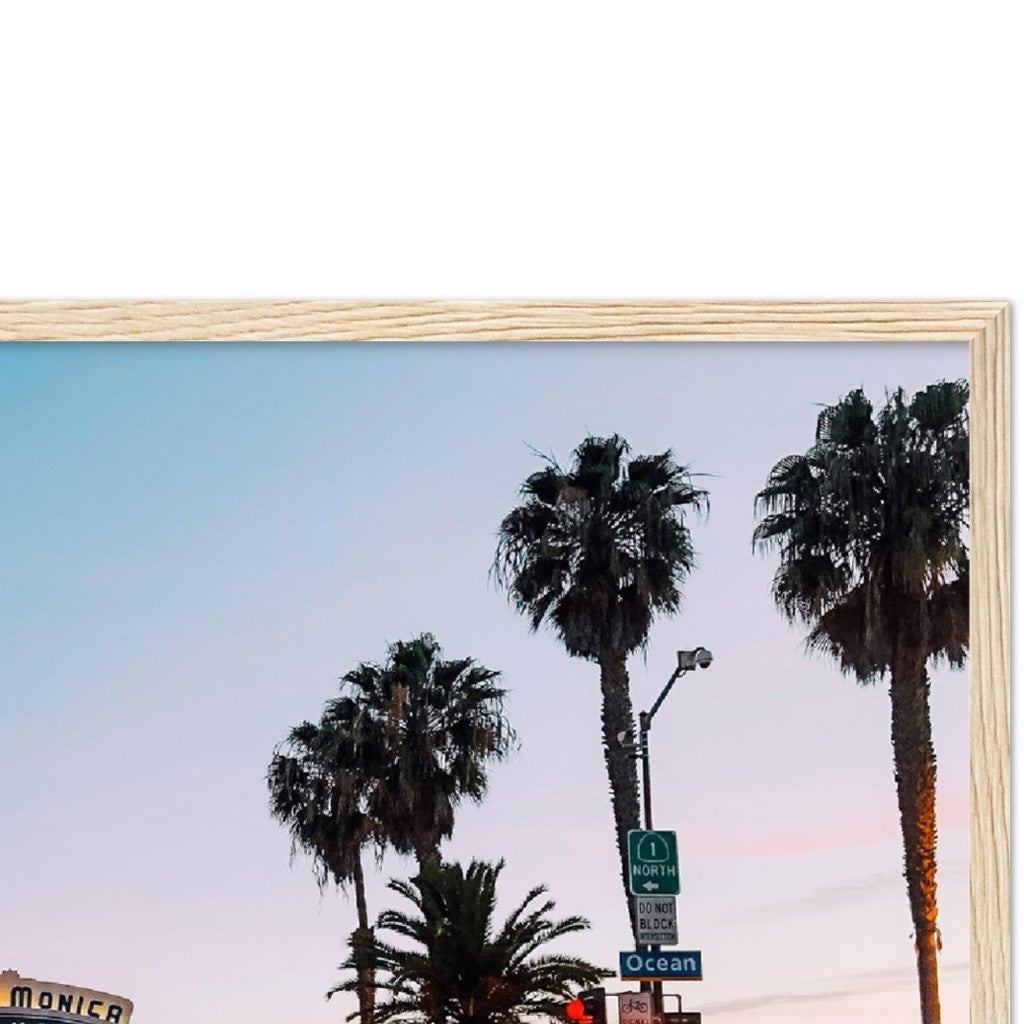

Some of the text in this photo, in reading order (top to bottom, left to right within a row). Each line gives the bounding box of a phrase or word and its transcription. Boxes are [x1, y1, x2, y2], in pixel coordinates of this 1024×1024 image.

[633, 864, 676, 877] NORTH
[639, 902, 674, 914] DO NOT
[640, 918, 675, 930] BLOCK
[626, 954, 696, 972] Ocean
[10, 986, 123, 1024] MONICA
